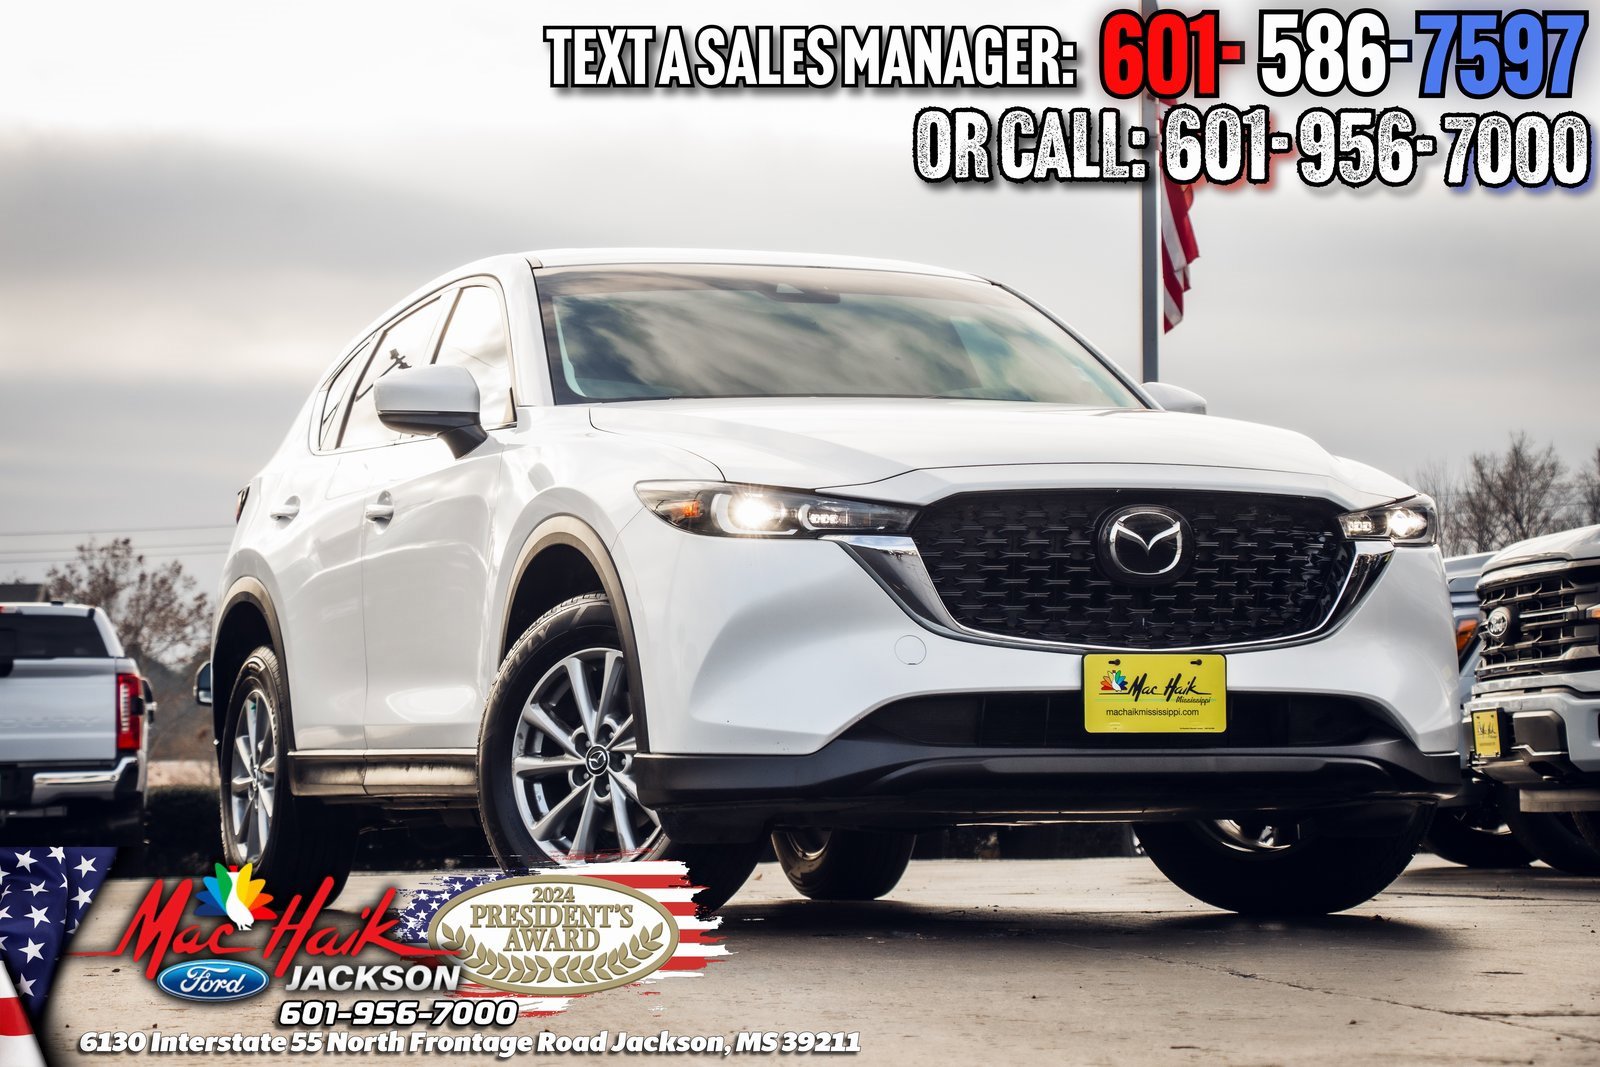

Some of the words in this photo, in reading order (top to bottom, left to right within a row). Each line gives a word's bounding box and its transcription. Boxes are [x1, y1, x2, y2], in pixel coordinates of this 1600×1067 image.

[1124, 673, 1160, 702] Mac
[1163, 673, 1205, 702] Haik
[1176, 696, 1211, 705] Mississippi
[1106, 708, 1200, 717] machaikmississippi.com
